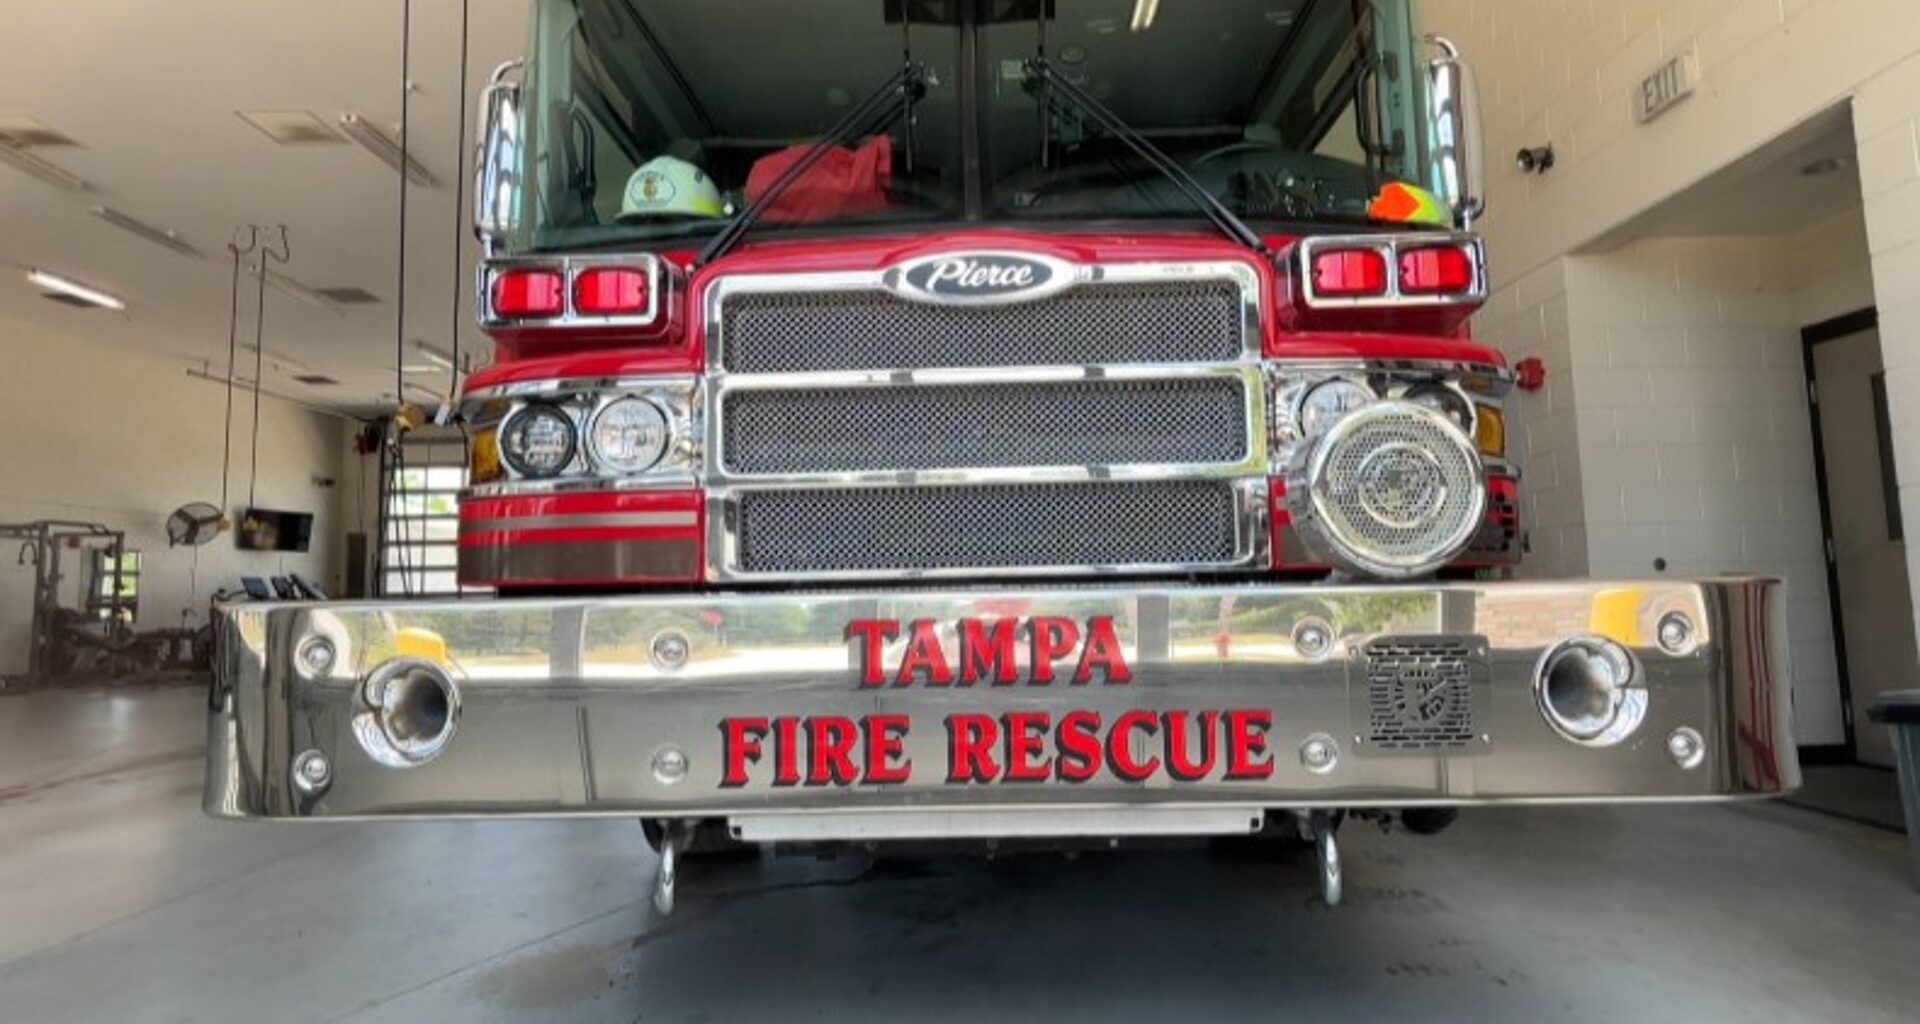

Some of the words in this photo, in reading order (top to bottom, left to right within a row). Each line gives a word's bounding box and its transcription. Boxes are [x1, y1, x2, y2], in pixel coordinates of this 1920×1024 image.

[1642, 57, 1678, 115] EXIT
[925, 257, 1034, 293] Pierce
[843, 614, 1133, 690] TAMPA
[718, 714, 912, 788] FIRE
[943, 709, 1274, 785] RESCUE
